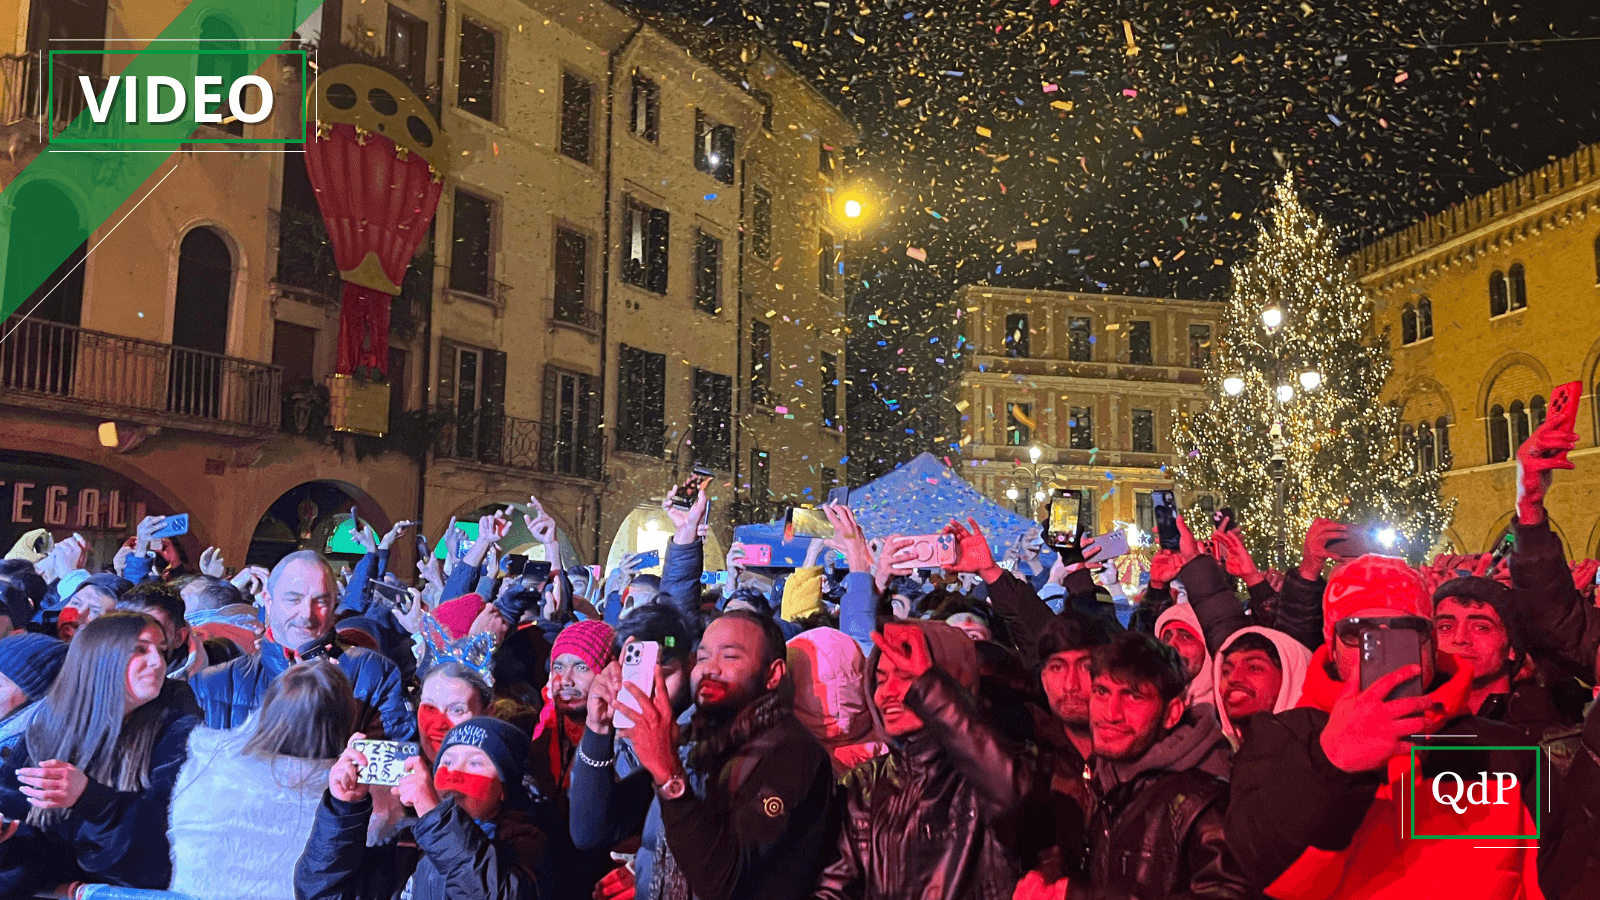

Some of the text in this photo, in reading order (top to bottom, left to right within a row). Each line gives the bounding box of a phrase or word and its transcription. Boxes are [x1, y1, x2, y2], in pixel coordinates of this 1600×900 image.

[0, 481, 127, 529] EGAL
[353, 741, 366, 780] DY
[381, 742, 397, 780] HAVE
